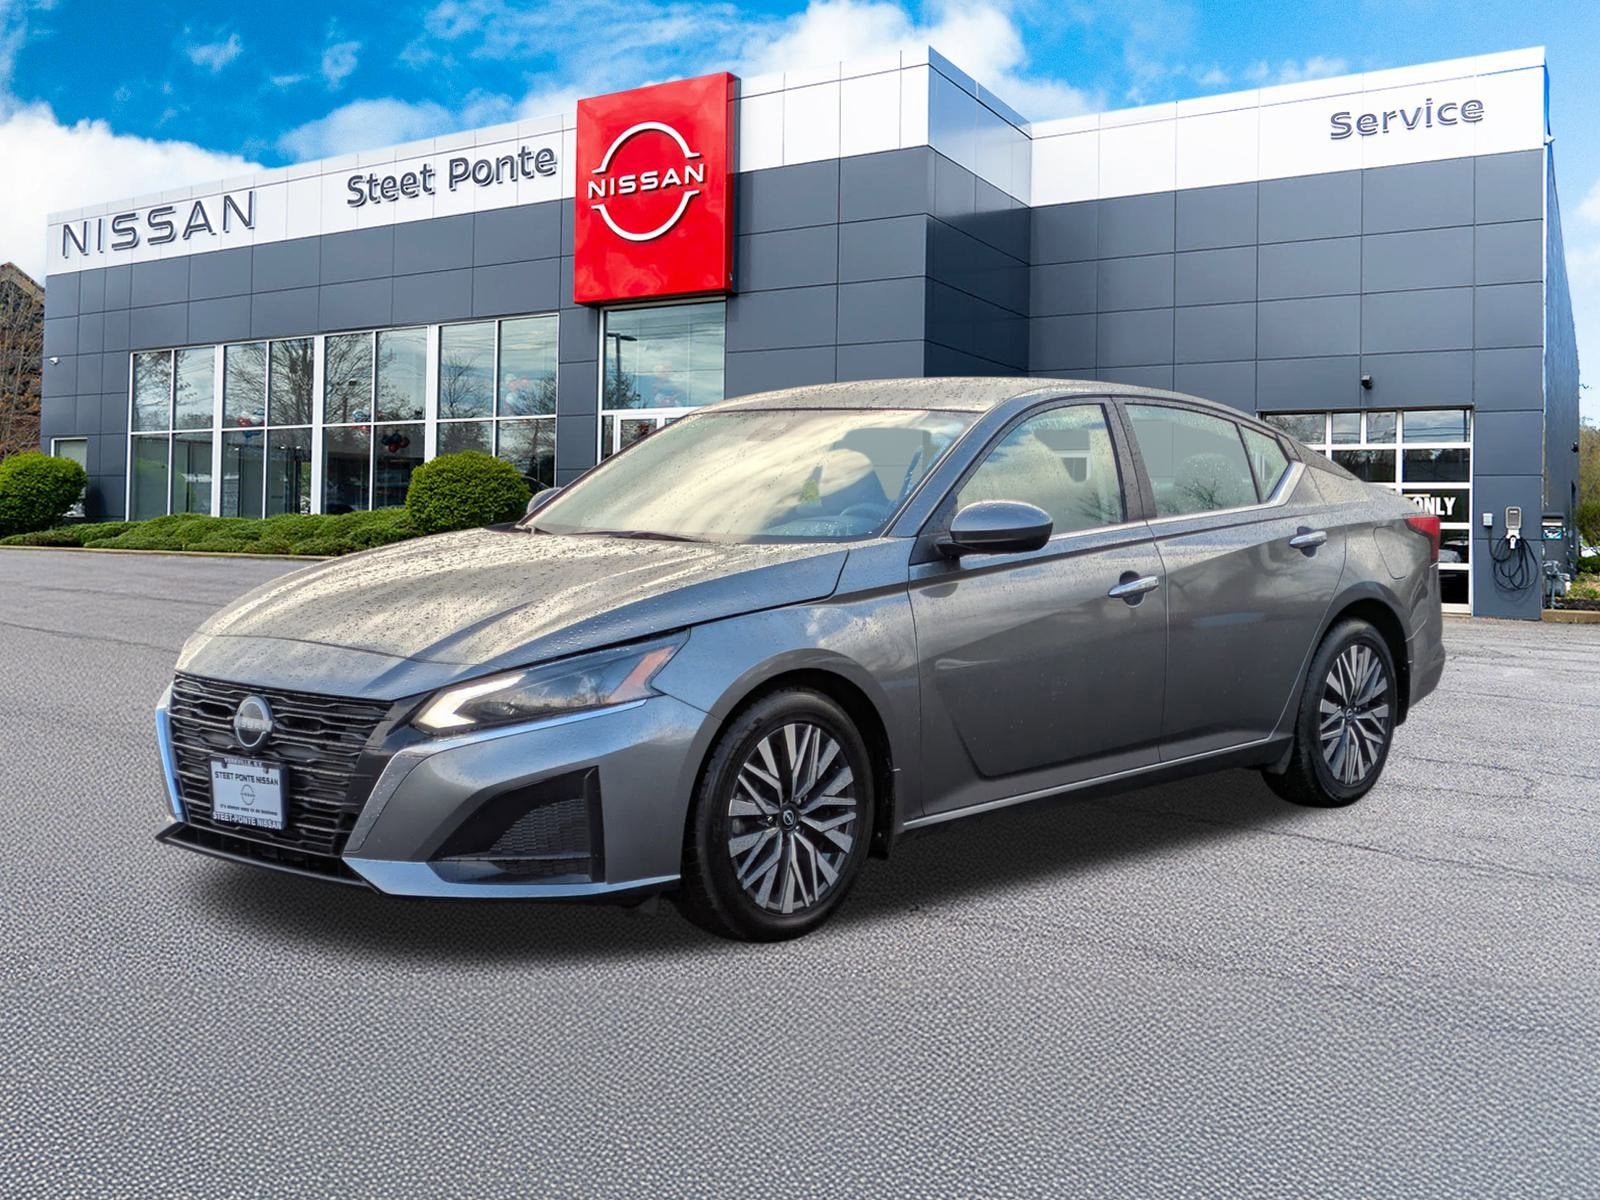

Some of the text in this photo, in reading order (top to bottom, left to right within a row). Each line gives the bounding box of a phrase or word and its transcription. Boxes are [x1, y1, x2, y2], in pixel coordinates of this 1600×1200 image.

[1330, 98, 1484, 140] Service
[347, 146, 557, 207] Steet Ponte
[587, 163, 705, 199] NISSAN
[62, 190, 255, 258] NISSAN
[214, 771, 279, 786] STEET PONTE NISSAN
[257, 817, 282, 830] NISSAN
